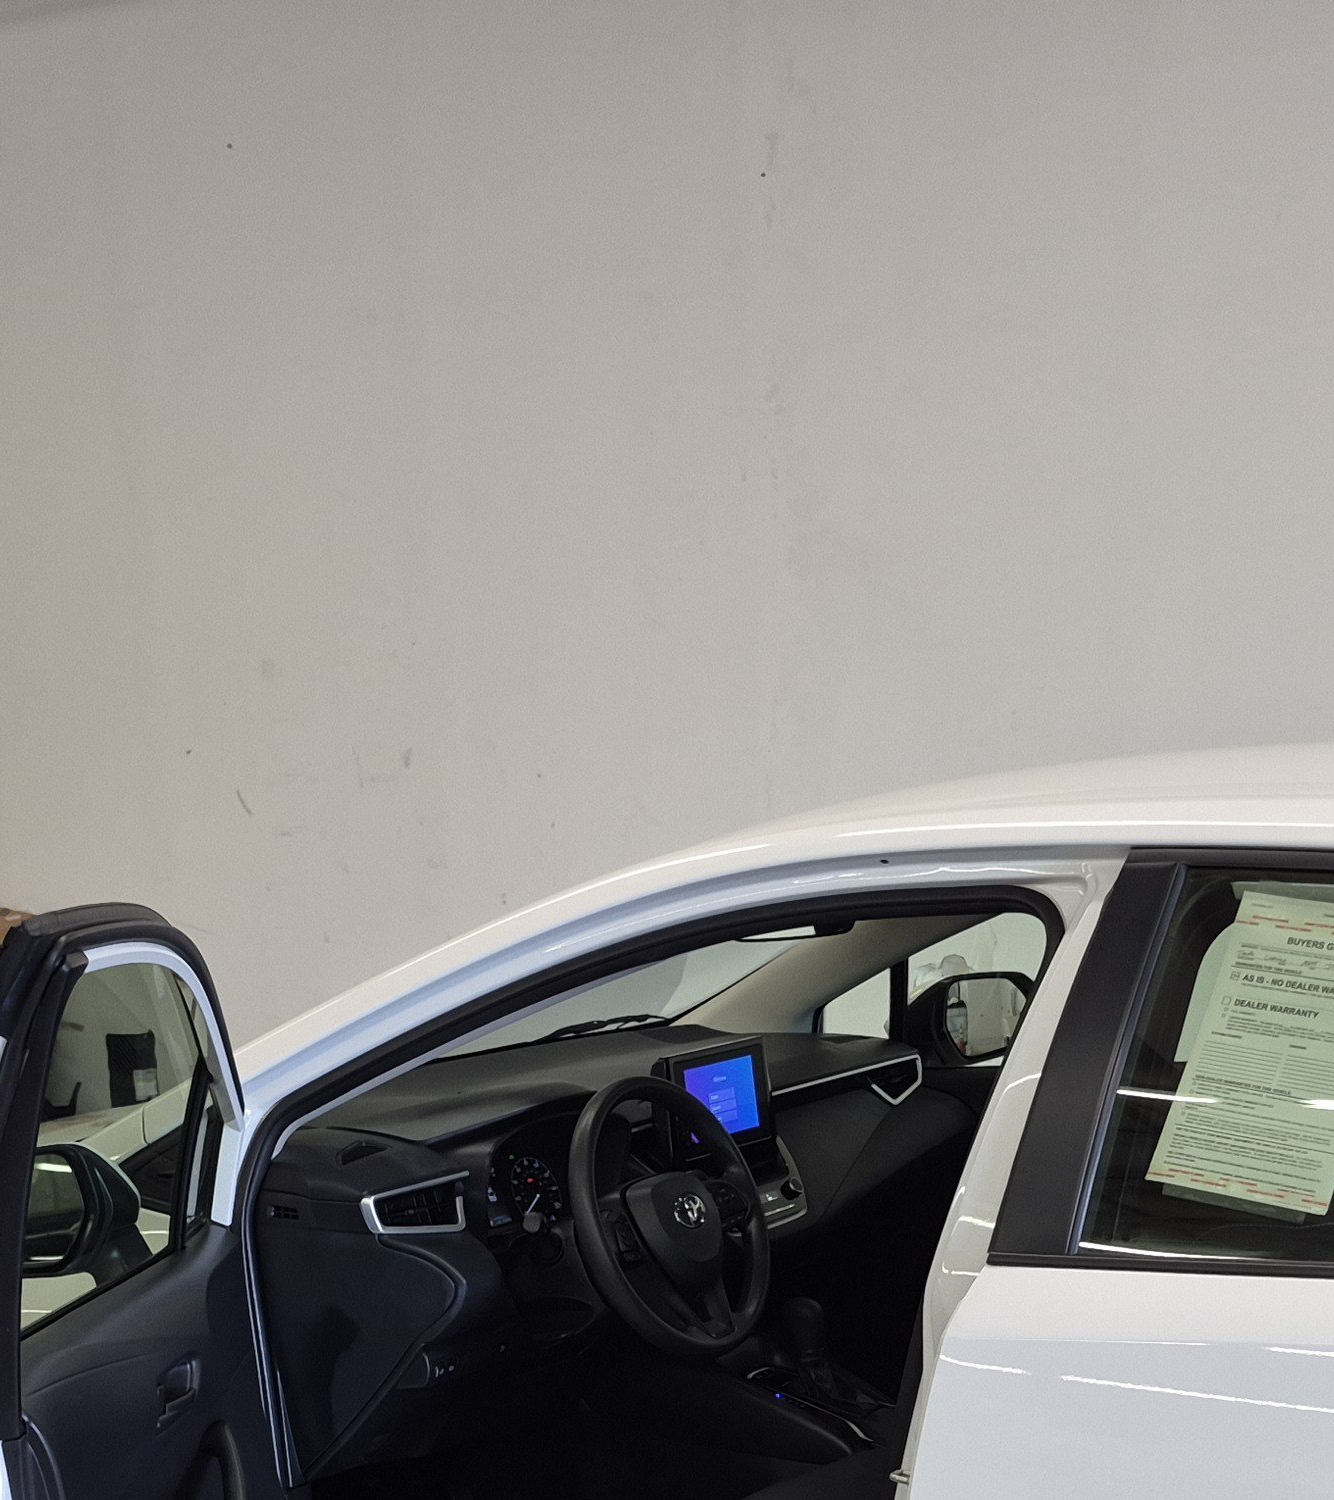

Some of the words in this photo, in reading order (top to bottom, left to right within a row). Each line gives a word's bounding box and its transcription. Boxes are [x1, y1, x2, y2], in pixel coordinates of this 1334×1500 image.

[1286, 936, 1325, 949] BUYERS
[1241, 973, 1255, 982] AS
[1254, 975, 1265, 984] IS
[1269, 977, 1285, 987] NO
[1284, 979, 1320, 992] DEALER
[1232, 998, 1269, 1011] DEALER
[1267, 1003, 1320, 1019] WARRANTY
